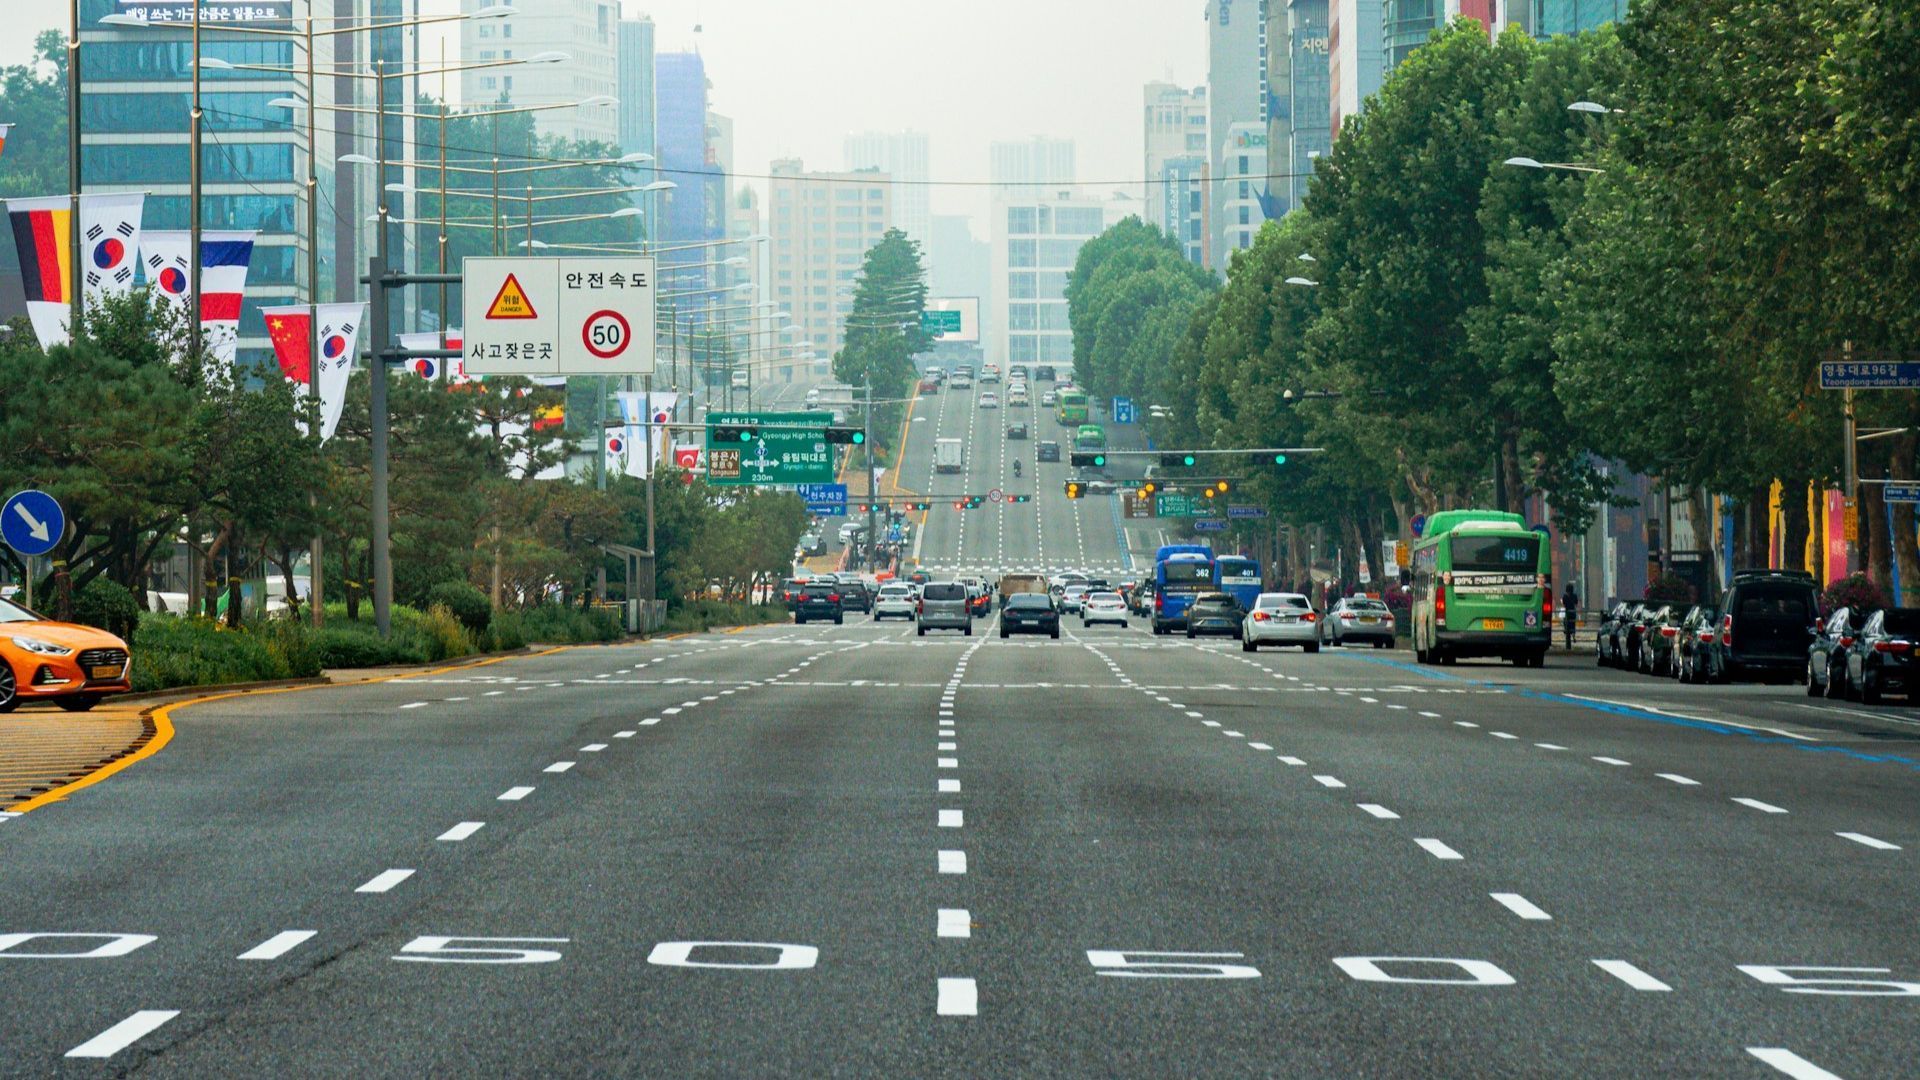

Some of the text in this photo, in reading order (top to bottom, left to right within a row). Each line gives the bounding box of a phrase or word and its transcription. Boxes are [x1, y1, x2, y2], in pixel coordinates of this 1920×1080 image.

[126, 7, 280, 20] 매일 쓰는 가구만큼은 일룸으로.
[566, 272, 648, 289] 안전속도
[503, 295, 519, 304] 위험
[593, 324, 620, 345] 50
[471, 342, 552, 360] 사고잦은곳
[1824, 364, 1897, 376] 영동대로96길
[1824, 378, 1897, 387] Yeongdong-daero
[762, 432, 791, 440] Gyeonggi
[792, 432, 806, 440] High
[710, 451, 739, 461] 봉은사
[782, 452, 828, 463] 올림픽대로
[1504, 549, 1528, 560] 4419
[1454, 577, 1473, 585] 100%
